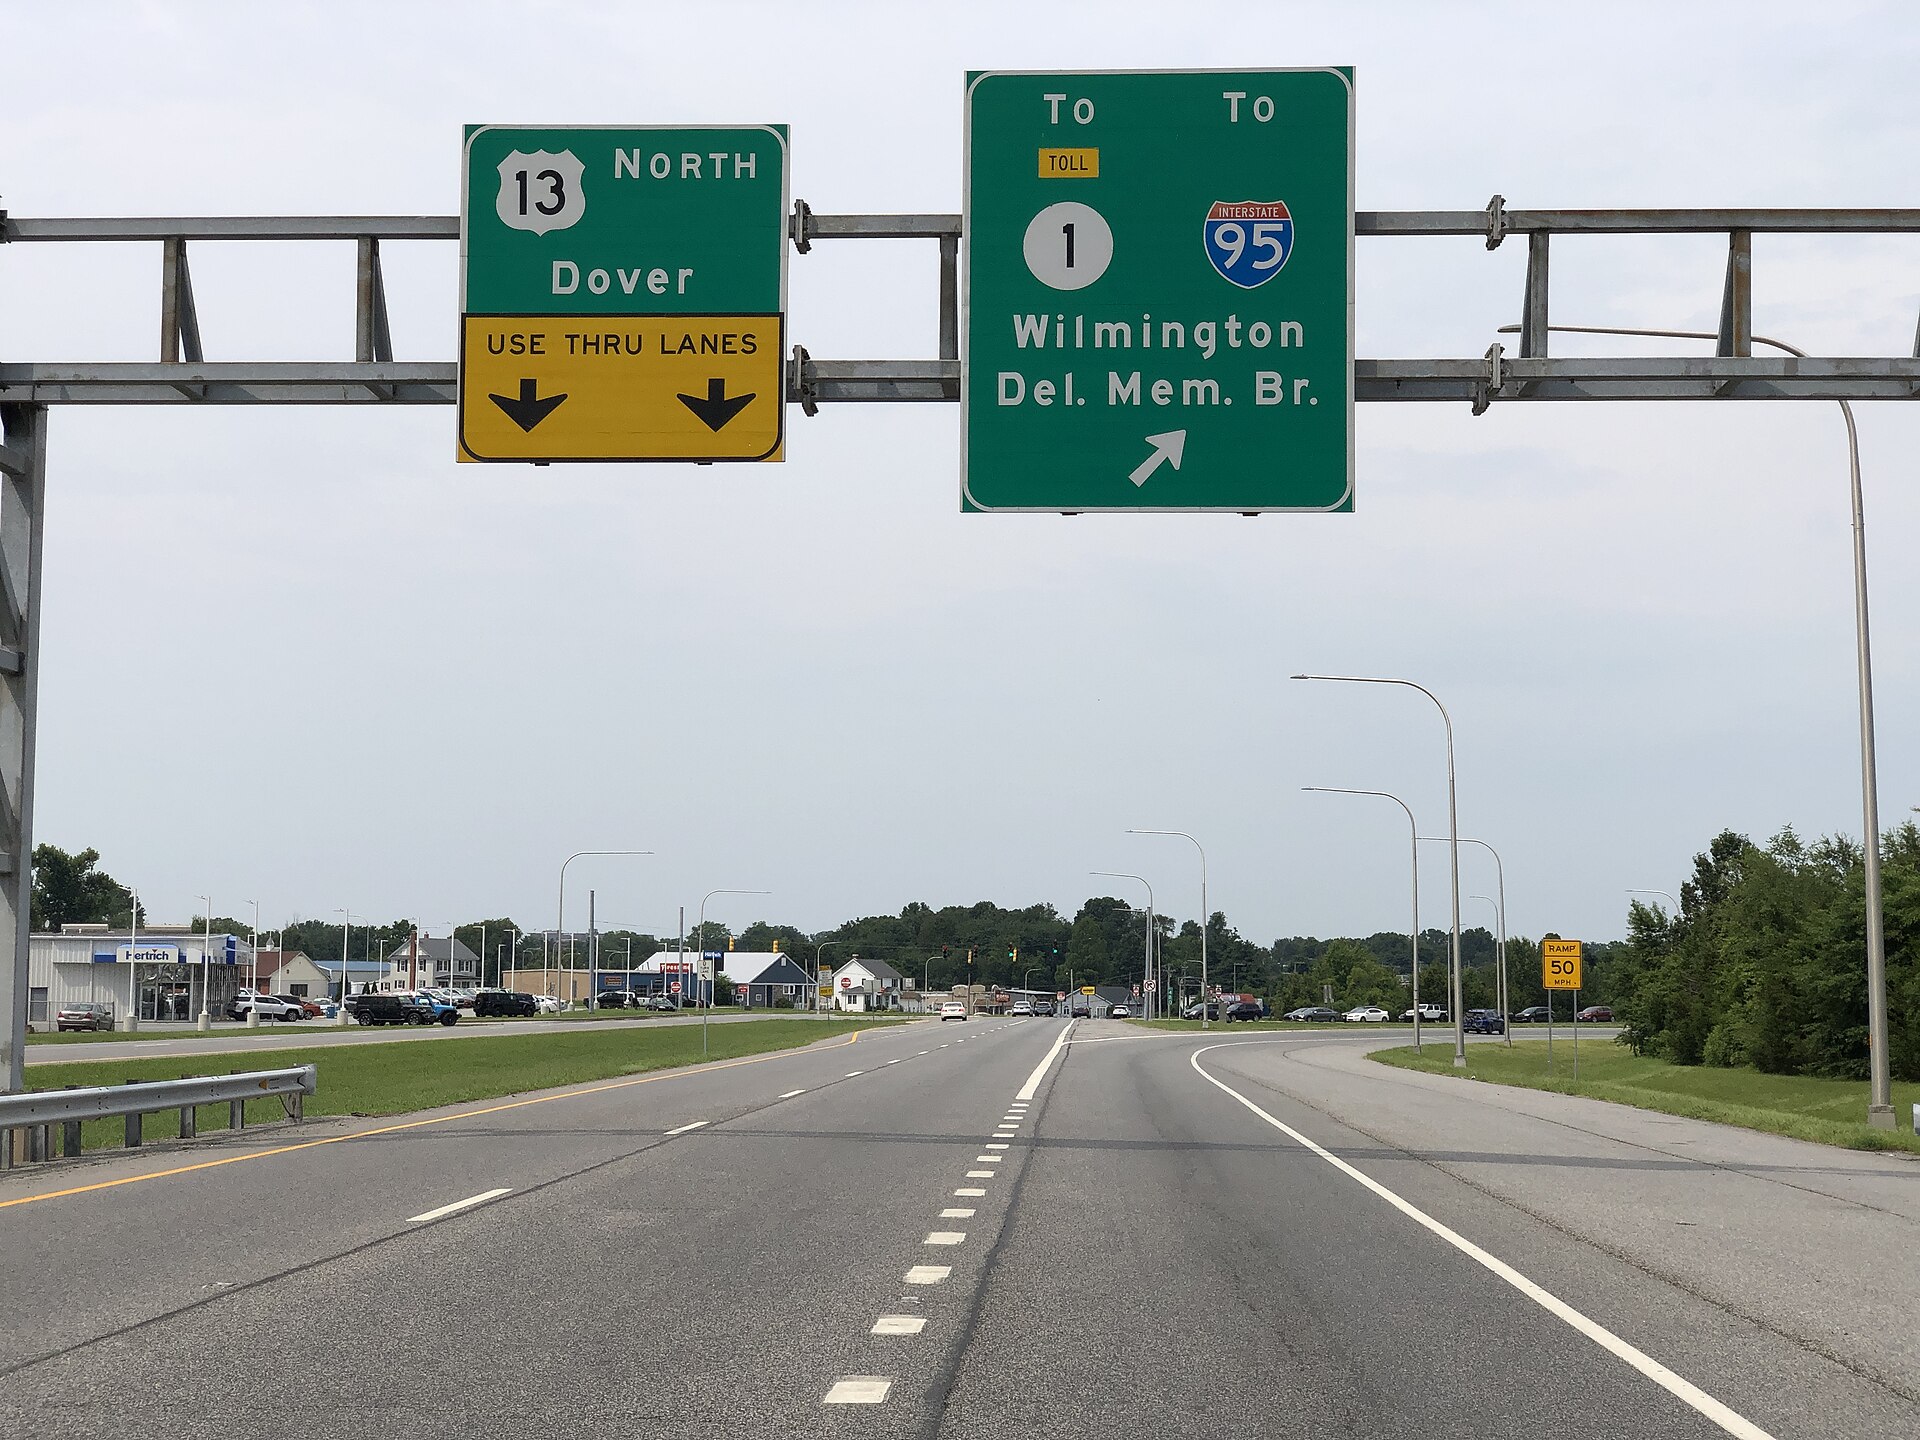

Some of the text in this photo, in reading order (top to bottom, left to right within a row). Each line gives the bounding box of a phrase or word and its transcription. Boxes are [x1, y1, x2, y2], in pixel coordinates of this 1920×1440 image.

[614, 148, 757, 180] NORTH
[1048, 155, 1089, 171] TOLL
[515, 170, 567, 216] 13
[1218, 206, 1280, 218] INTERSTATE
[1062, 223, 1075, 269] 1
[1213, 223, 1284, 270] 95
[552, 260, 694, 296] Dover
[487, 333, 758, 356] USE THRU LANES
[1013, 313, 1305, 360] Wilmington
[997, 371, 1319, 407] Del. Mem. Br.
[126, 949, 169, 960] Hertrich
[1551, 960, 1574, 975] 50
